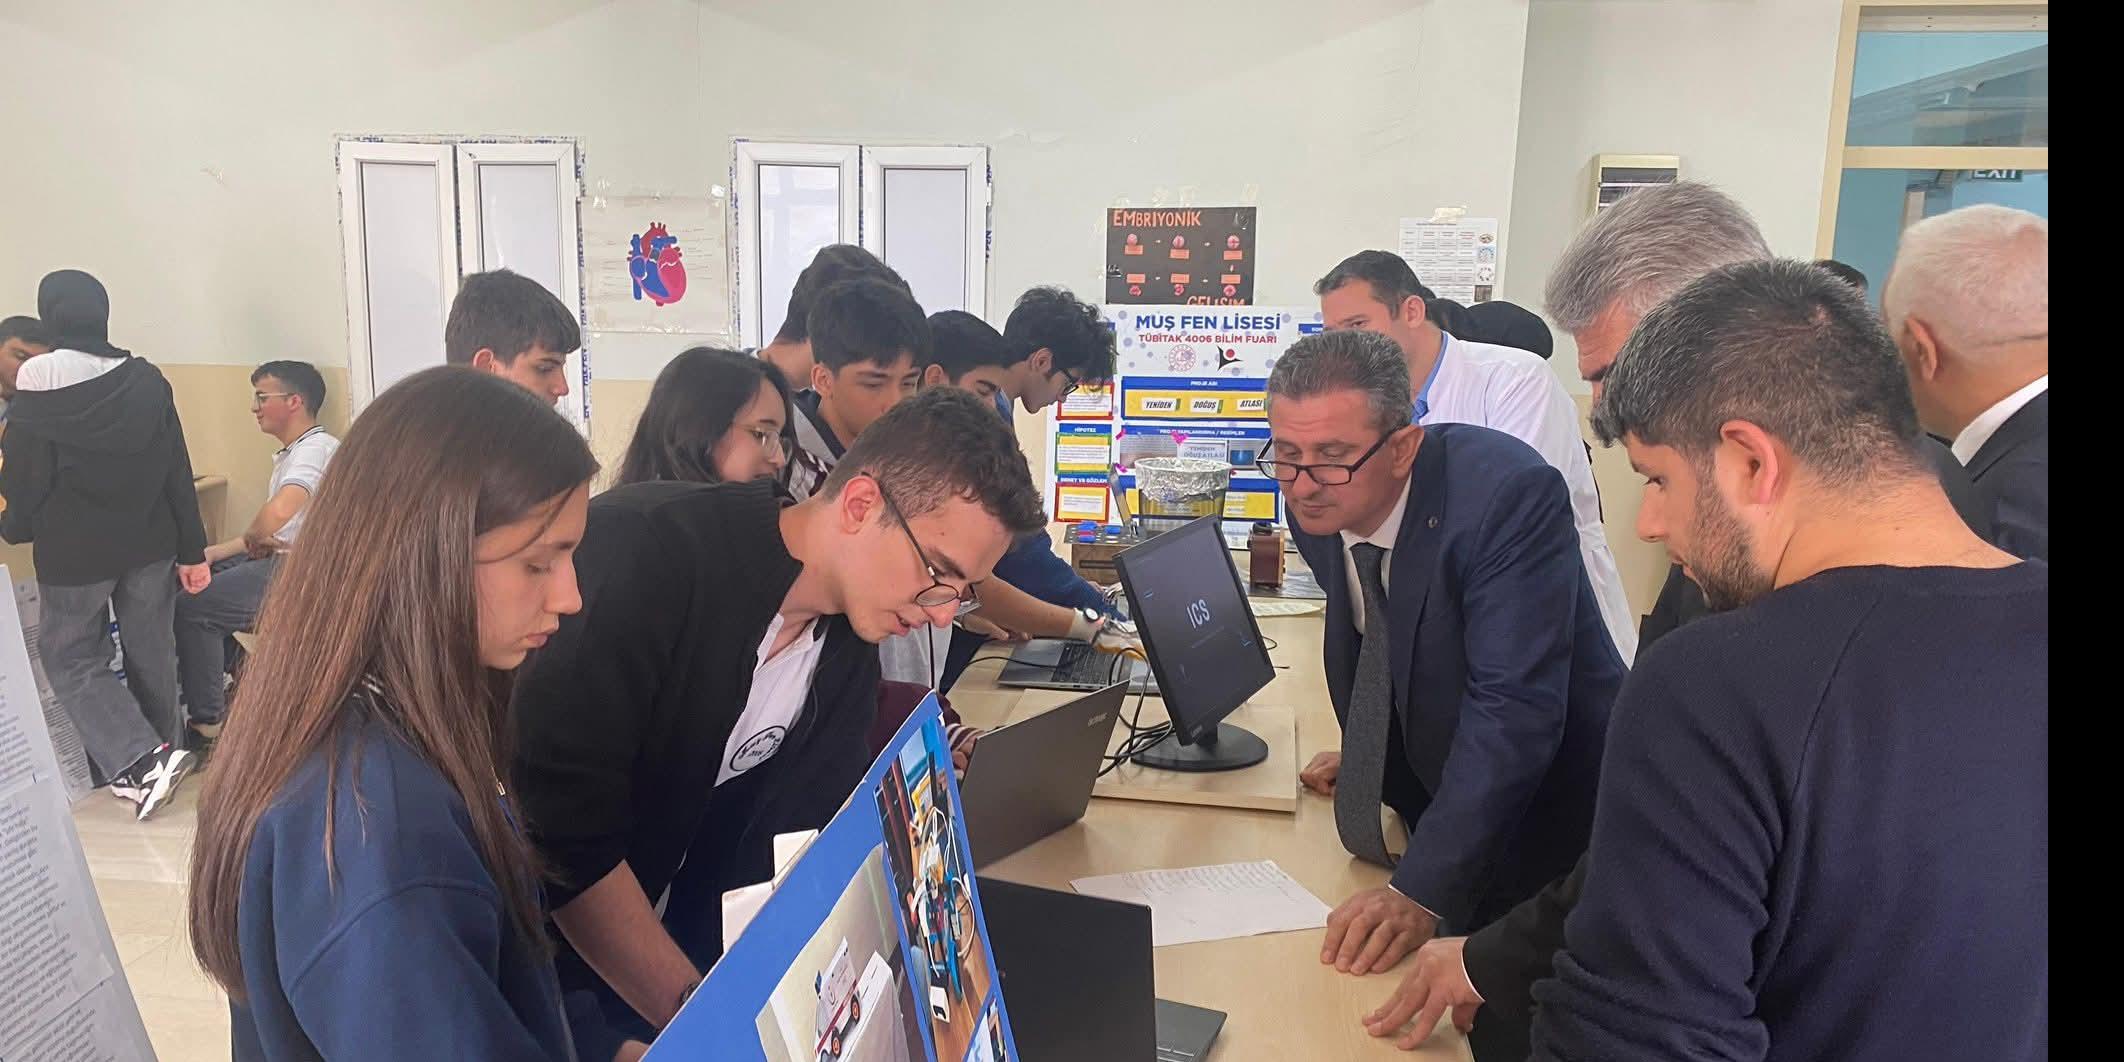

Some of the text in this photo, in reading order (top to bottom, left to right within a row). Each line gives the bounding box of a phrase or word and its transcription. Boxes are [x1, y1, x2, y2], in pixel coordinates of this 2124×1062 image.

[1136, 313, 1281, 331] MUŞ FEN LİSESİ
[1139, 333, 1277, 343] TÜBİTAK 4006 BİLİM FUARI
[1186, 599, 1210, 629] ICS
